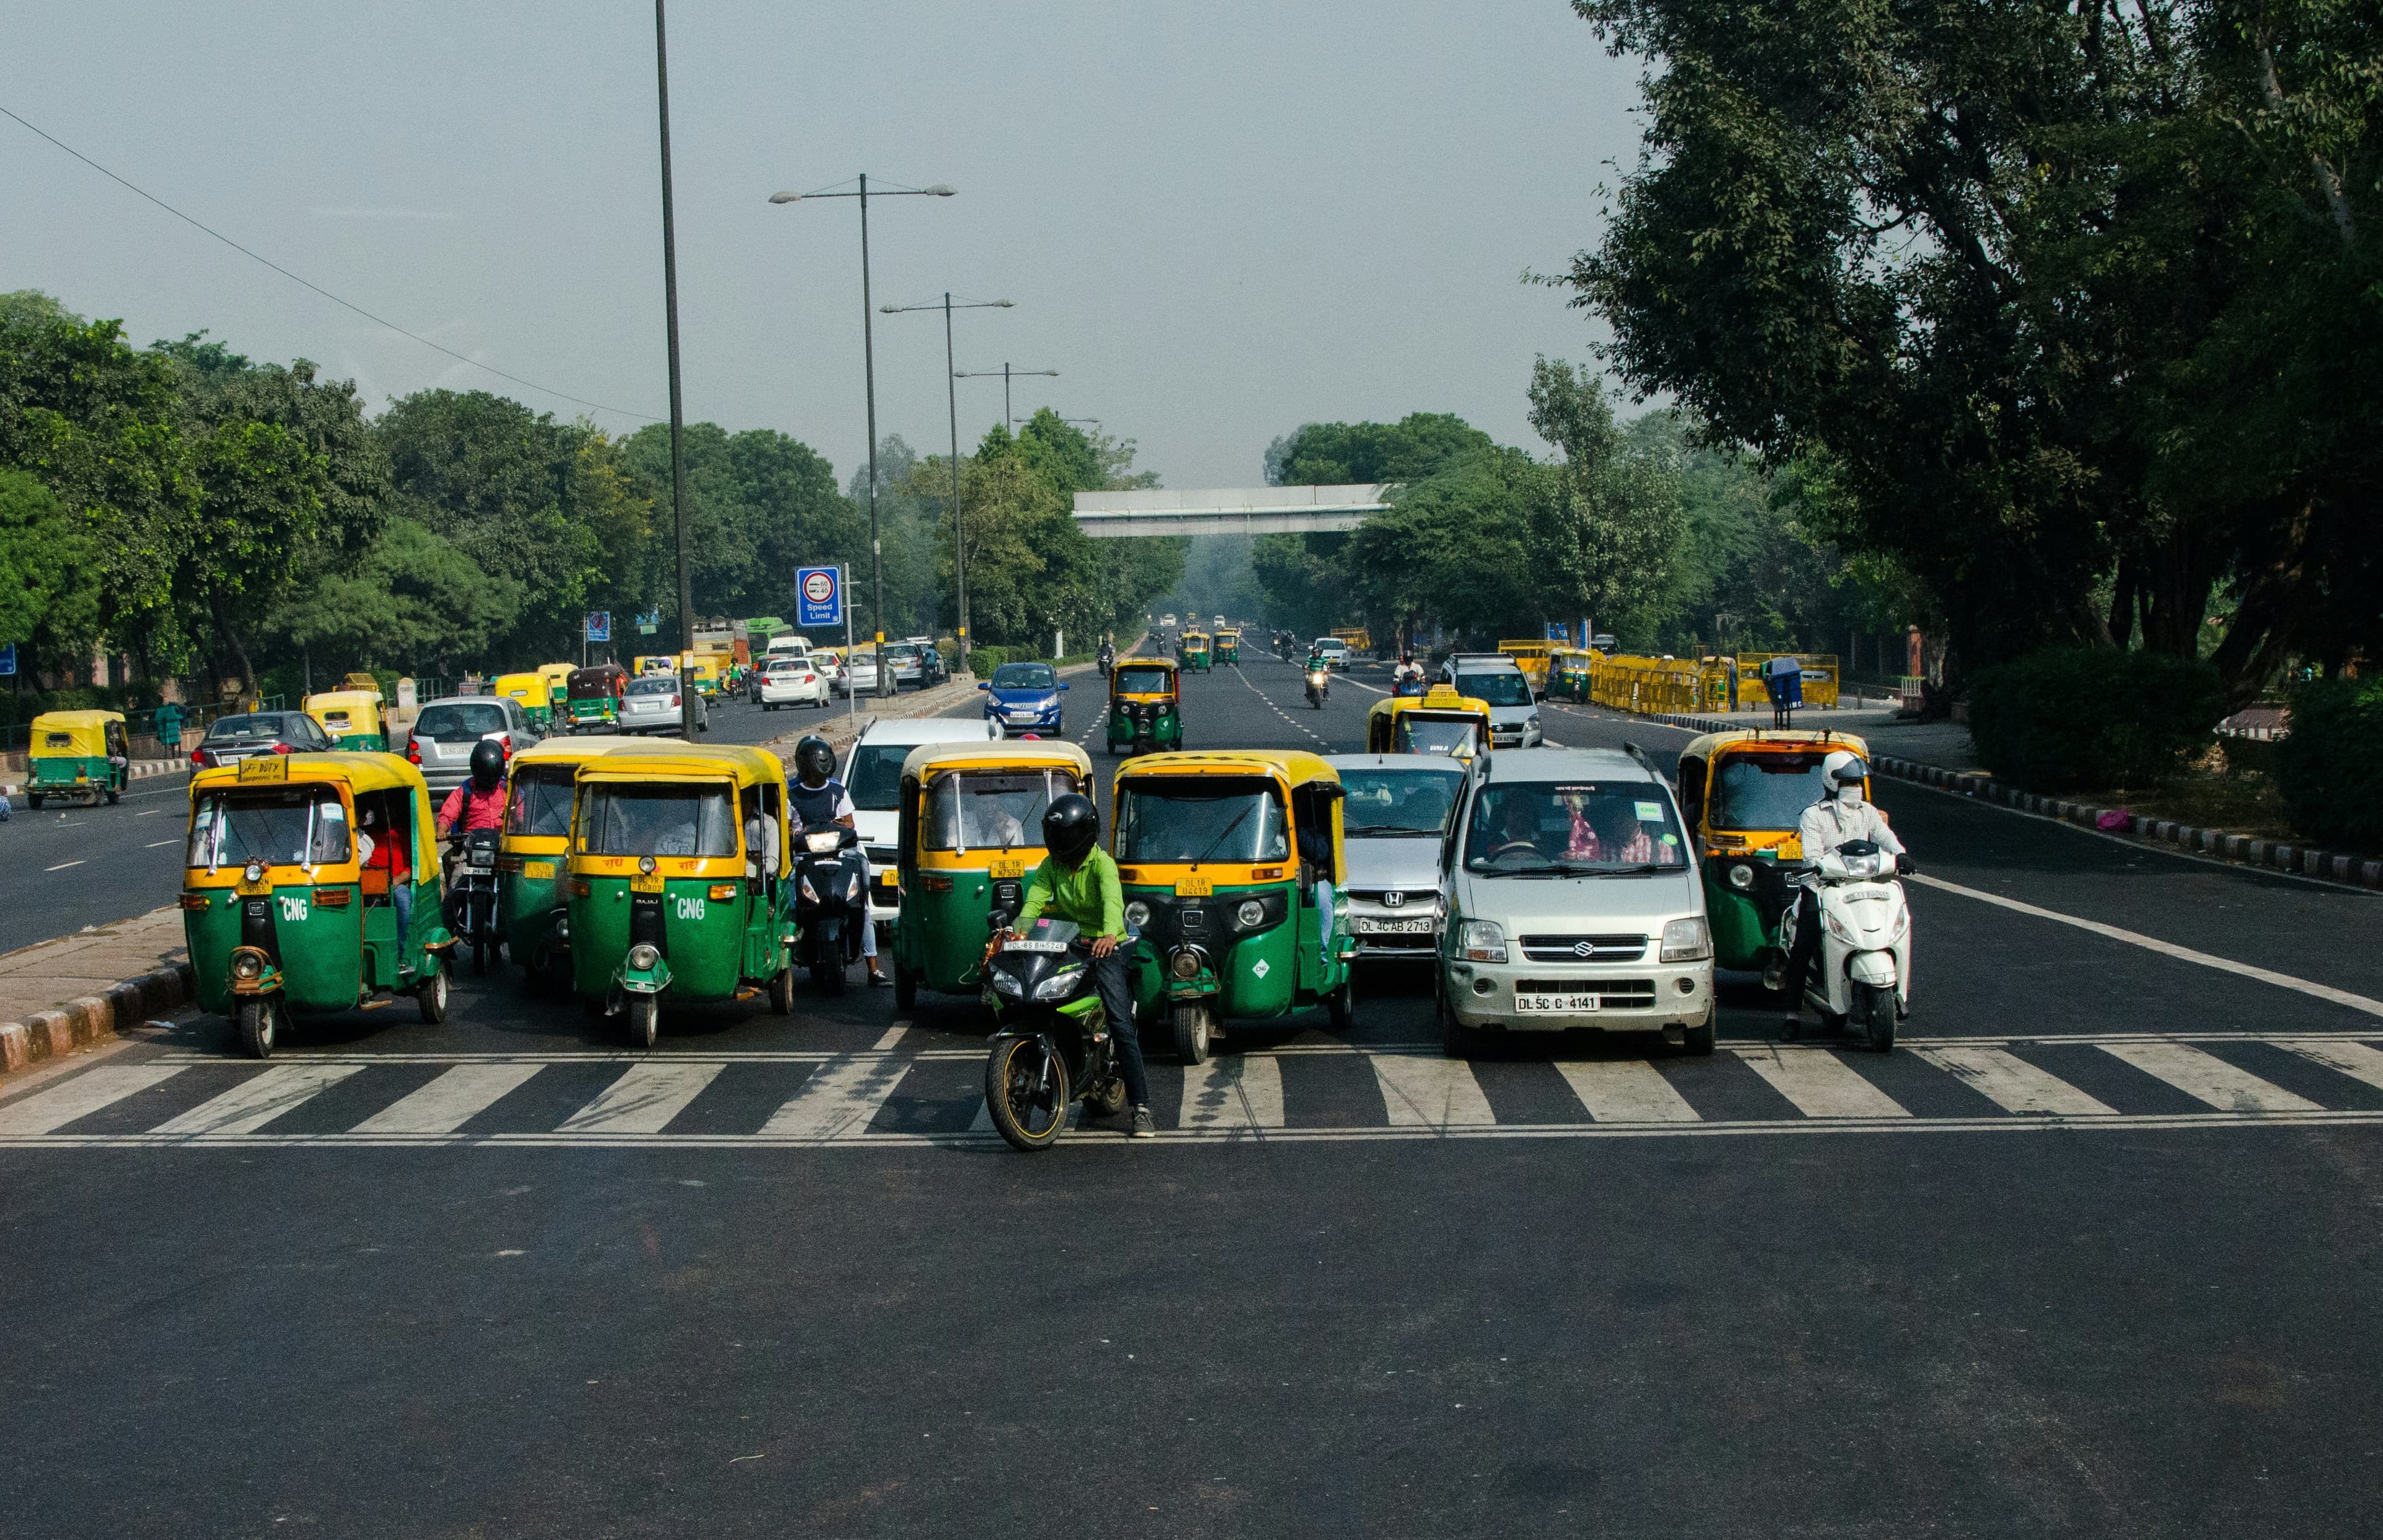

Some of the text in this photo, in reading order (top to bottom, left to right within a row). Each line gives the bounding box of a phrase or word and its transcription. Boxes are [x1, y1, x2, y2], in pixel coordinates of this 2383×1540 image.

[807, 604, 832, 612] Speed
[283, 898, 307, 921] CNG
[677, 898, 704, 920] CNG
[1362, 921, 1429, 931] DL 4C AB 2713
[1519, 998, 1533, 1010] DL
[1536, 998, 1549, 1010] 5C
[1569, 997, 1594, 1009] 4141
